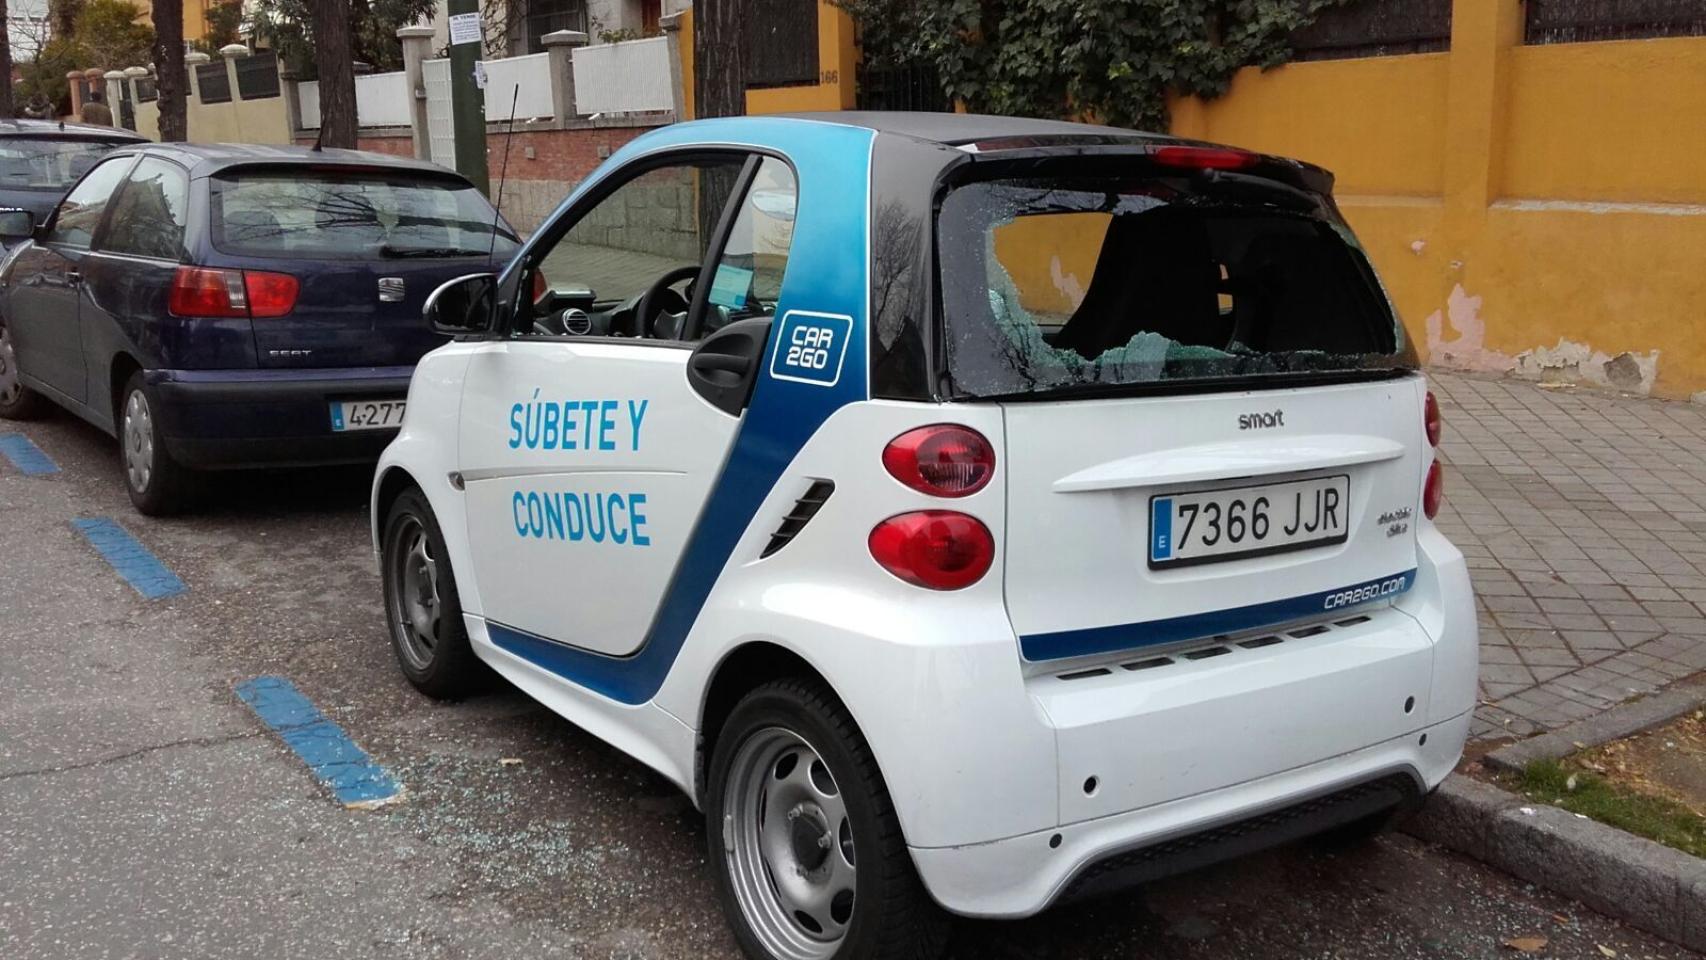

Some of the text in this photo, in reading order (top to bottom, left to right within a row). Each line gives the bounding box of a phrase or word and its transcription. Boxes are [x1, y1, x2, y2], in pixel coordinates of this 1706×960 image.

[821, 70, 838, 84] 166
[791, 325, 833, 349] CAR
[785, 346, 828, 370] 2GO
[508, 387, 649, 451] SÚBETE Y
[1238, 408, 1285, 430] smart
[512, 490, 651, 547] CONDUCE
[1158, 535, 1167, 549] E
[1177, 496, 1270, 550] 7366
[1283, 487, 1340, 536] JJR
[1323, 576, 1407, 610] CAR2GO.COM
